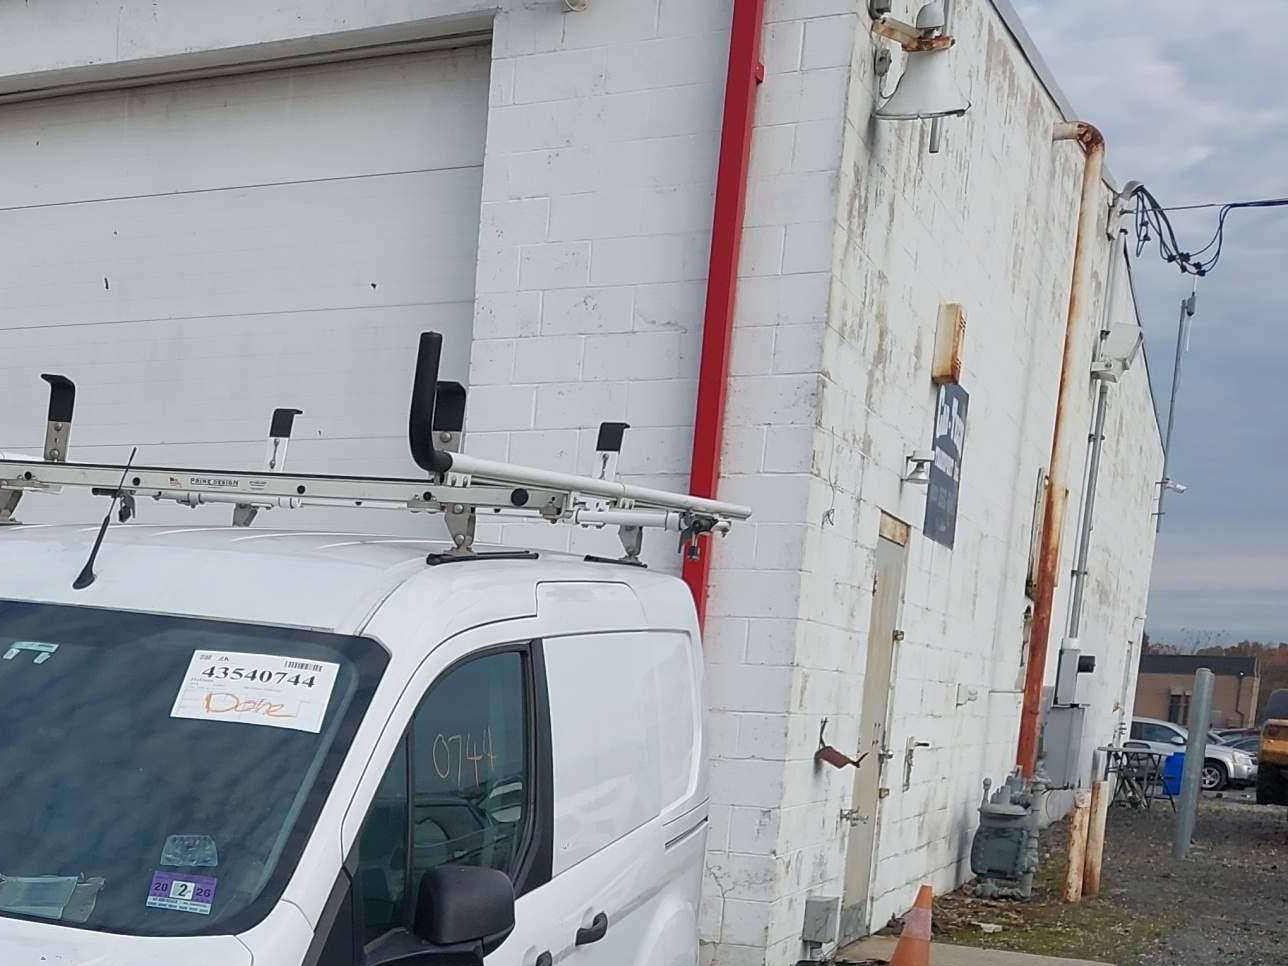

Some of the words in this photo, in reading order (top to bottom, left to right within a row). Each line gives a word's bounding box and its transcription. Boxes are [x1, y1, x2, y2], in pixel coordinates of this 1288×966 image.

[201, 665, 316, 688] 43540744
[432, 726, 497, 790] 0744
[154, 882, 168, 892] 20
[178, 883, 188, 897] 2
